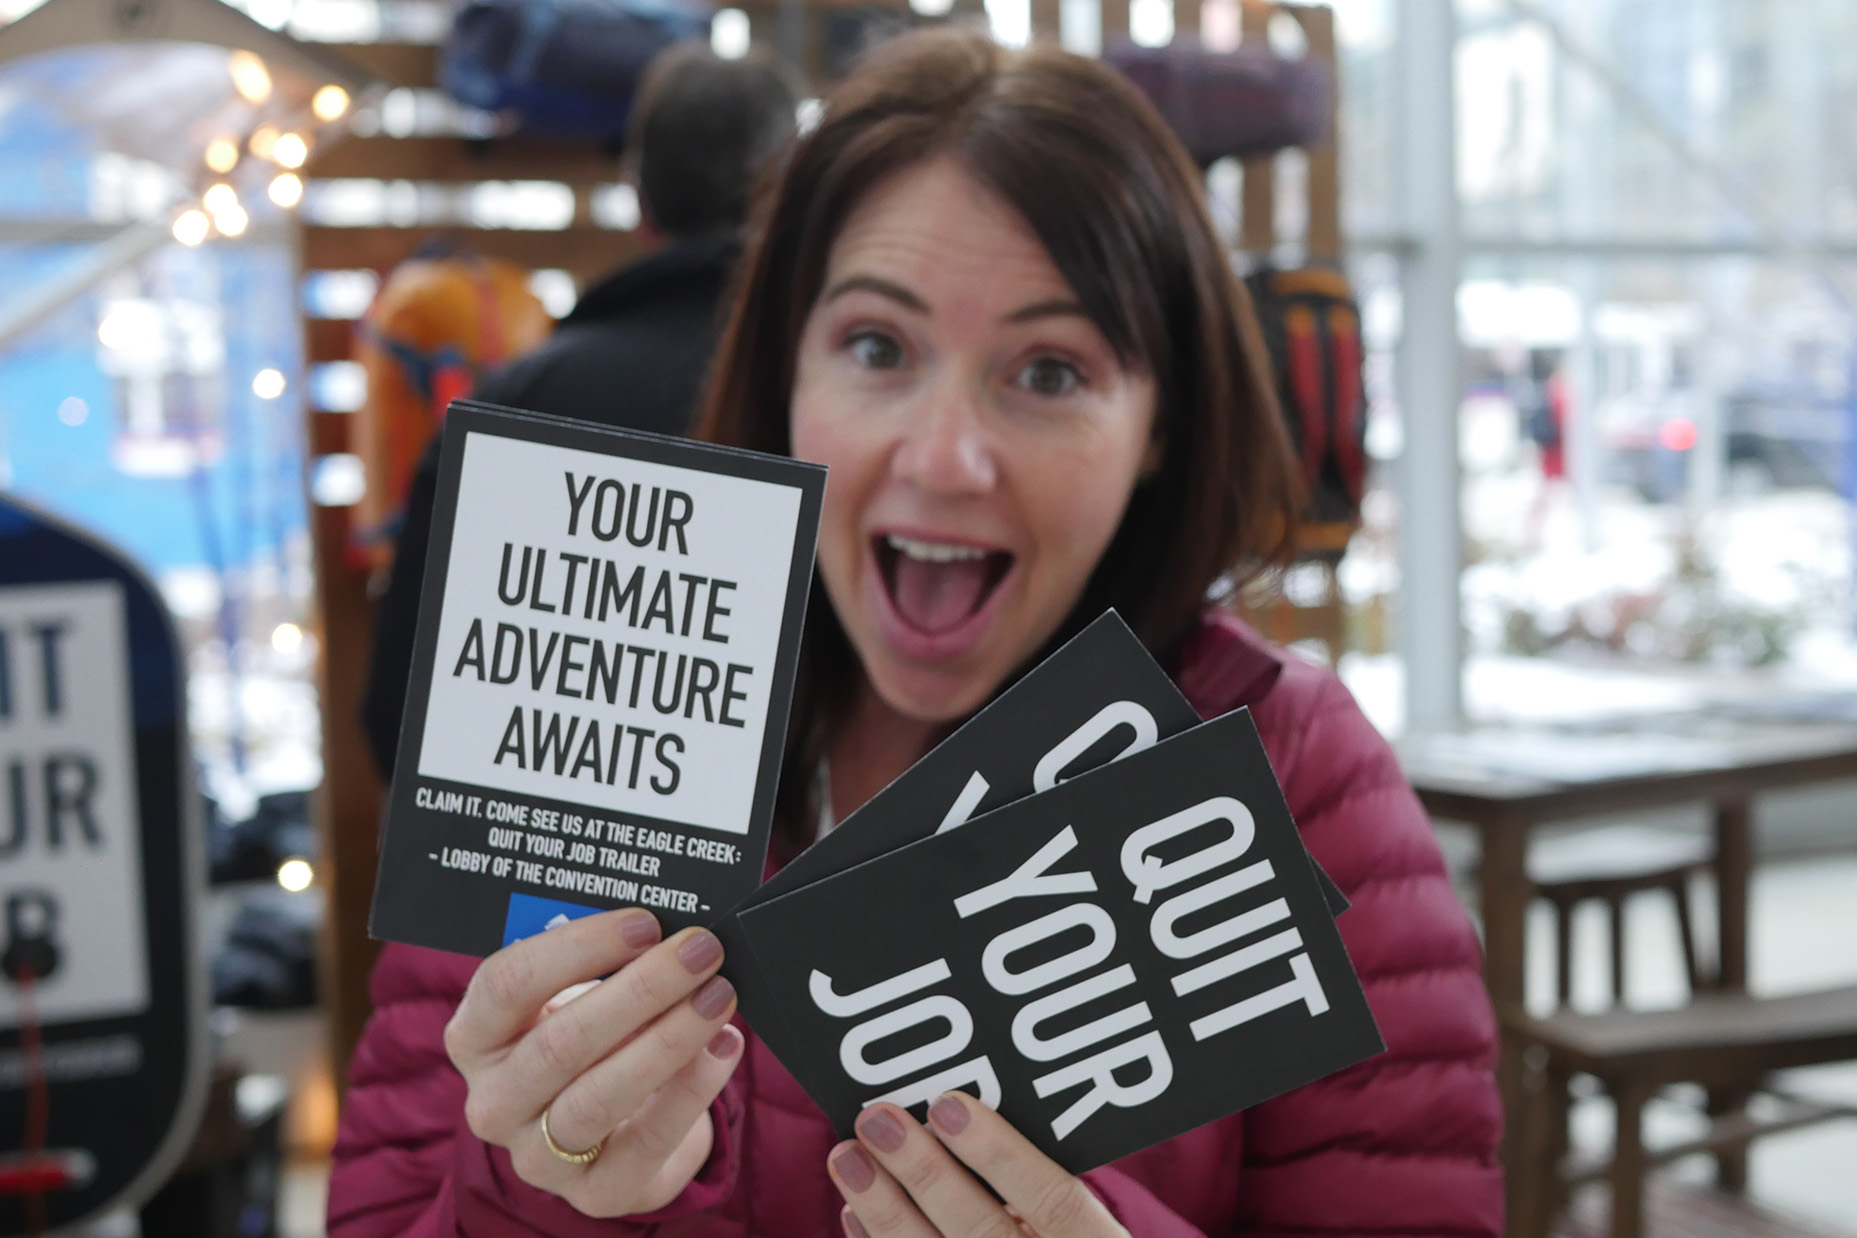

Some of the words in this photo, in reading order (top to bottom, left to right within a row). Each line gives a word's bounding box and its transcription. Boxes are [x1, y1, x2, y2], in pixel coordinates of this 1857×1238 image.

[564, 471, 694, 555] YOUR
[497, 542, 737, 644] ULTIMATE
[453, 617, 754, 729] ADVENTURE
[493, 705, 685, 796] AWAITS
[415, 787, 464, 815] CLAIM
[465, 795, 482, 818] IT.
[486, 800, 529, 826] COME
[531, 807, 560, 832] SEE
[562, 813, 583, 836] US
[584, 818, 605, 840] AT
[607, 821, 635, 846] THE
[636, 827, 685, 855] EAGLE
[686, 837, 742, 865] CREEK:
[488, 827, 524, 851] QUIT
[526, 833, 565, 860] YOUR
[566, 841, 596, 865] JOB
[598, 847, 661, 877] TRAILER
[441, 847, 491, 874] LOBBY
[492, 856, 513, 878] OF
[515, 860, 544, 884] THE
[545, 866, 638, 902] CONVENTION
[640, 884, 698, 913] CENTER
[1120, 796, 1330, 1042] QUIT
[953, 824, 1174, 1141] YOUR
